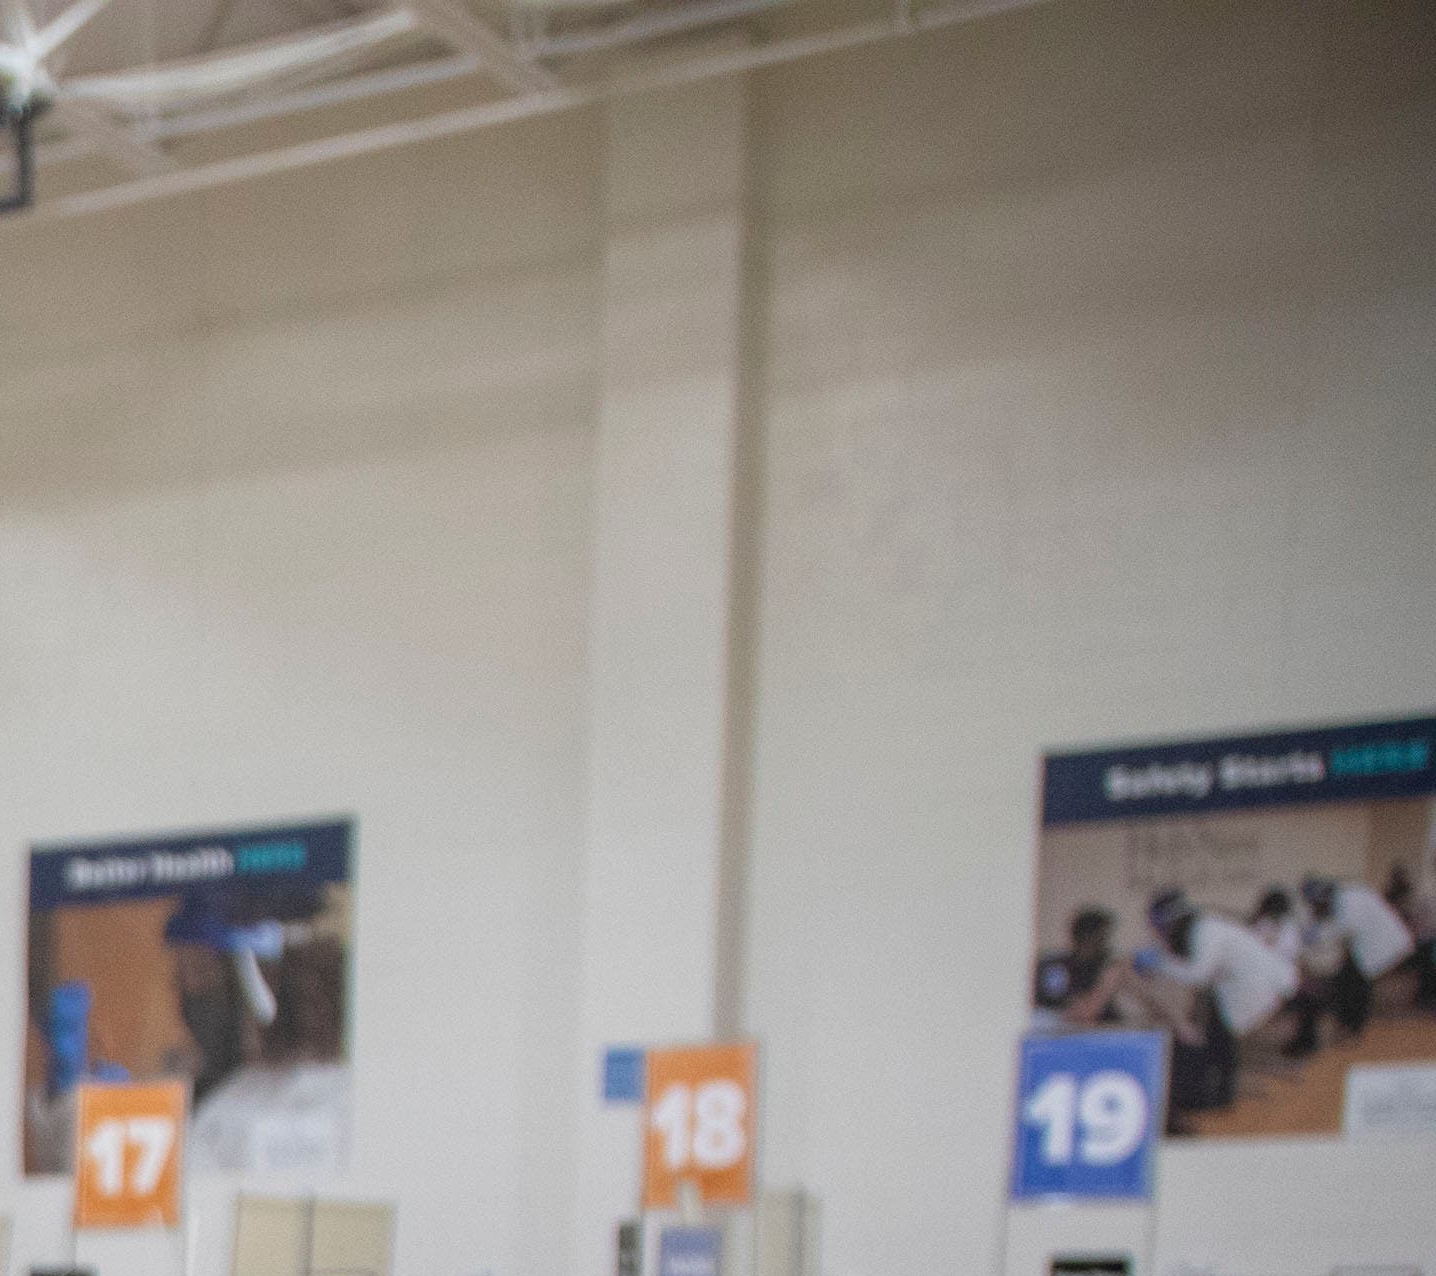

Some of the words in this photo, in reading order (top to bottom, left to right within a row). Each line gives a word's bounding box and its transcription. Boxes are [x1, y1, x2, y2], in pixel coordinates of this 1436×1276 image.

[87, 1117, 176, 1197] 17
[651, 1078, 747, 1170] 18
[1025, 1070, 1148, 1166] 19
